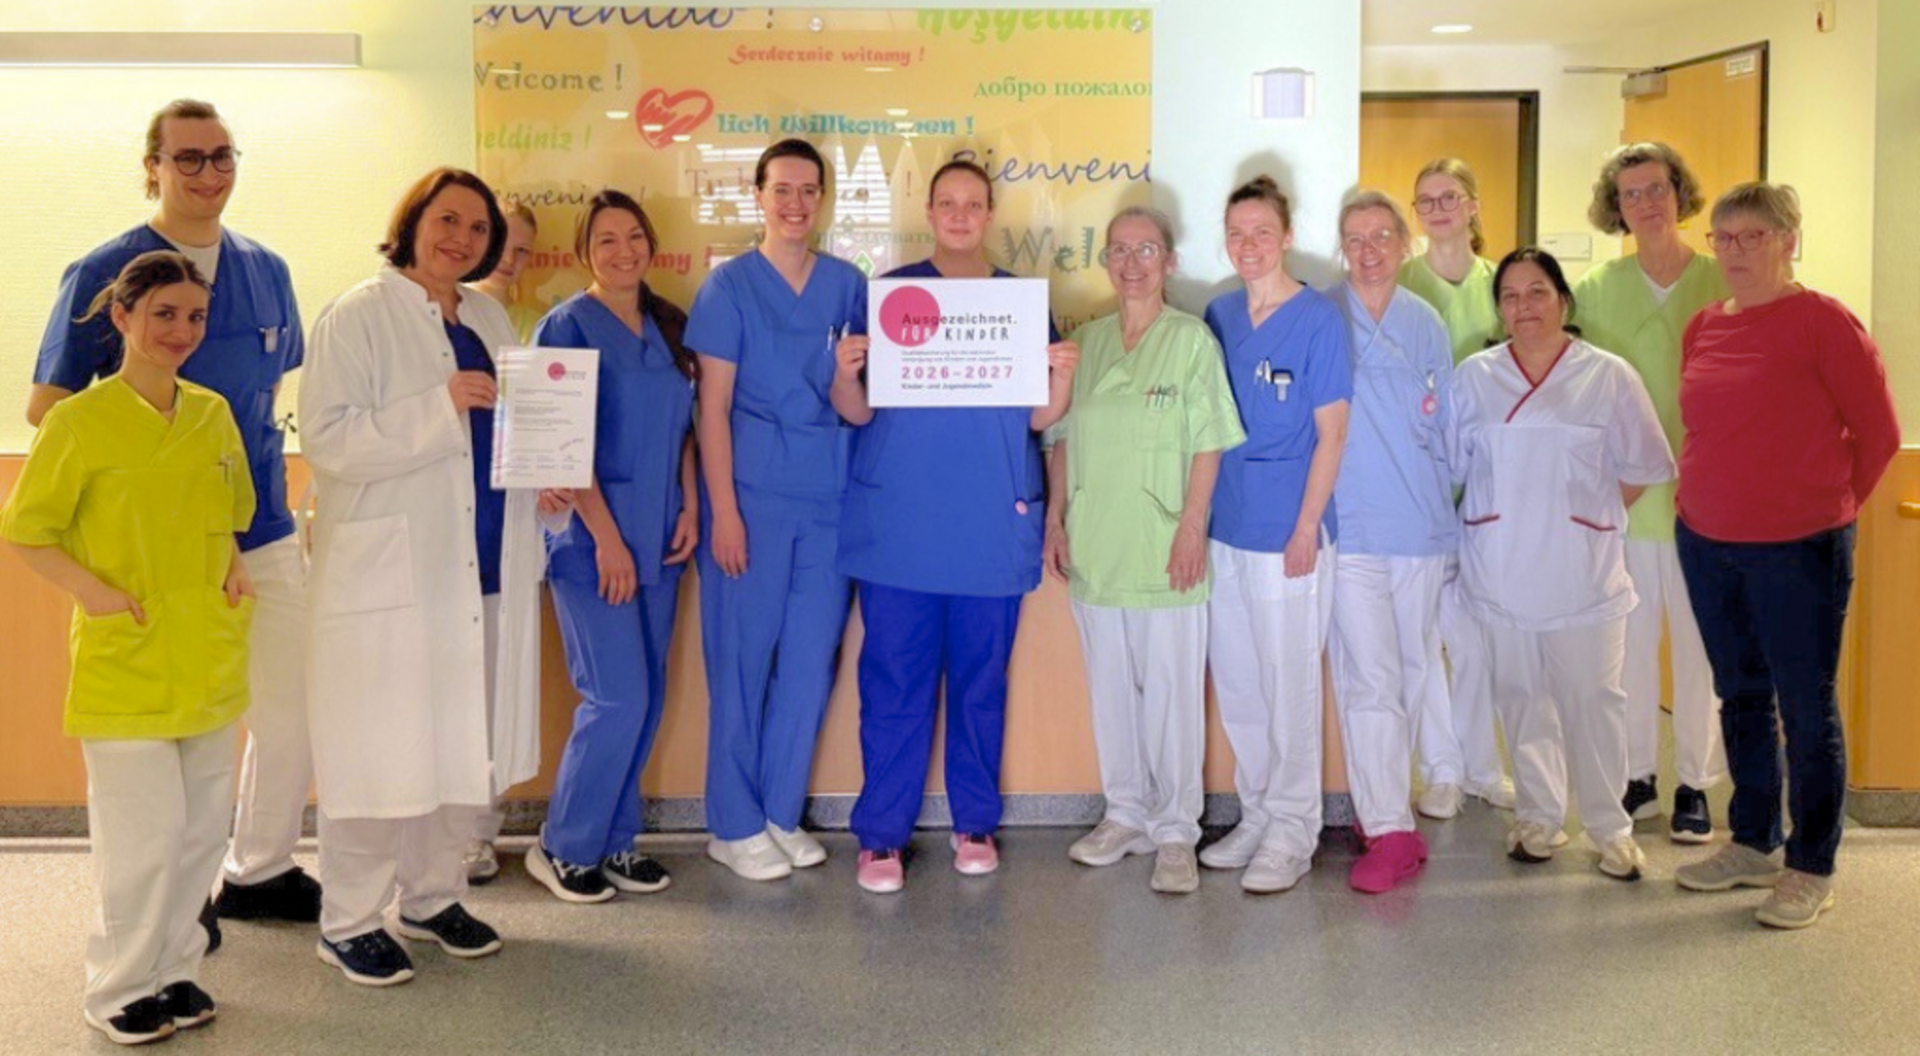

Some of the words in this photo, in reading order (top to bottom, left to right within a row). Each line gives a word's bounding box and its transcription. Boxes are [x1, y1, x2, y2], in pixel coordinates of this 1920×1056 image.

[841, 46, 911, 67] witamy
[614, 63, 623, 91] !
[973, 76, 1047, 101] добро
[1054, 80, 1152, 97] пожало
[965, 115, 974, 135] !
[583, 124, 592, 149] !
[902, 313, 1017, 327] Ausgezeichnet.
[945, 327, 1009, 341] KINDER
